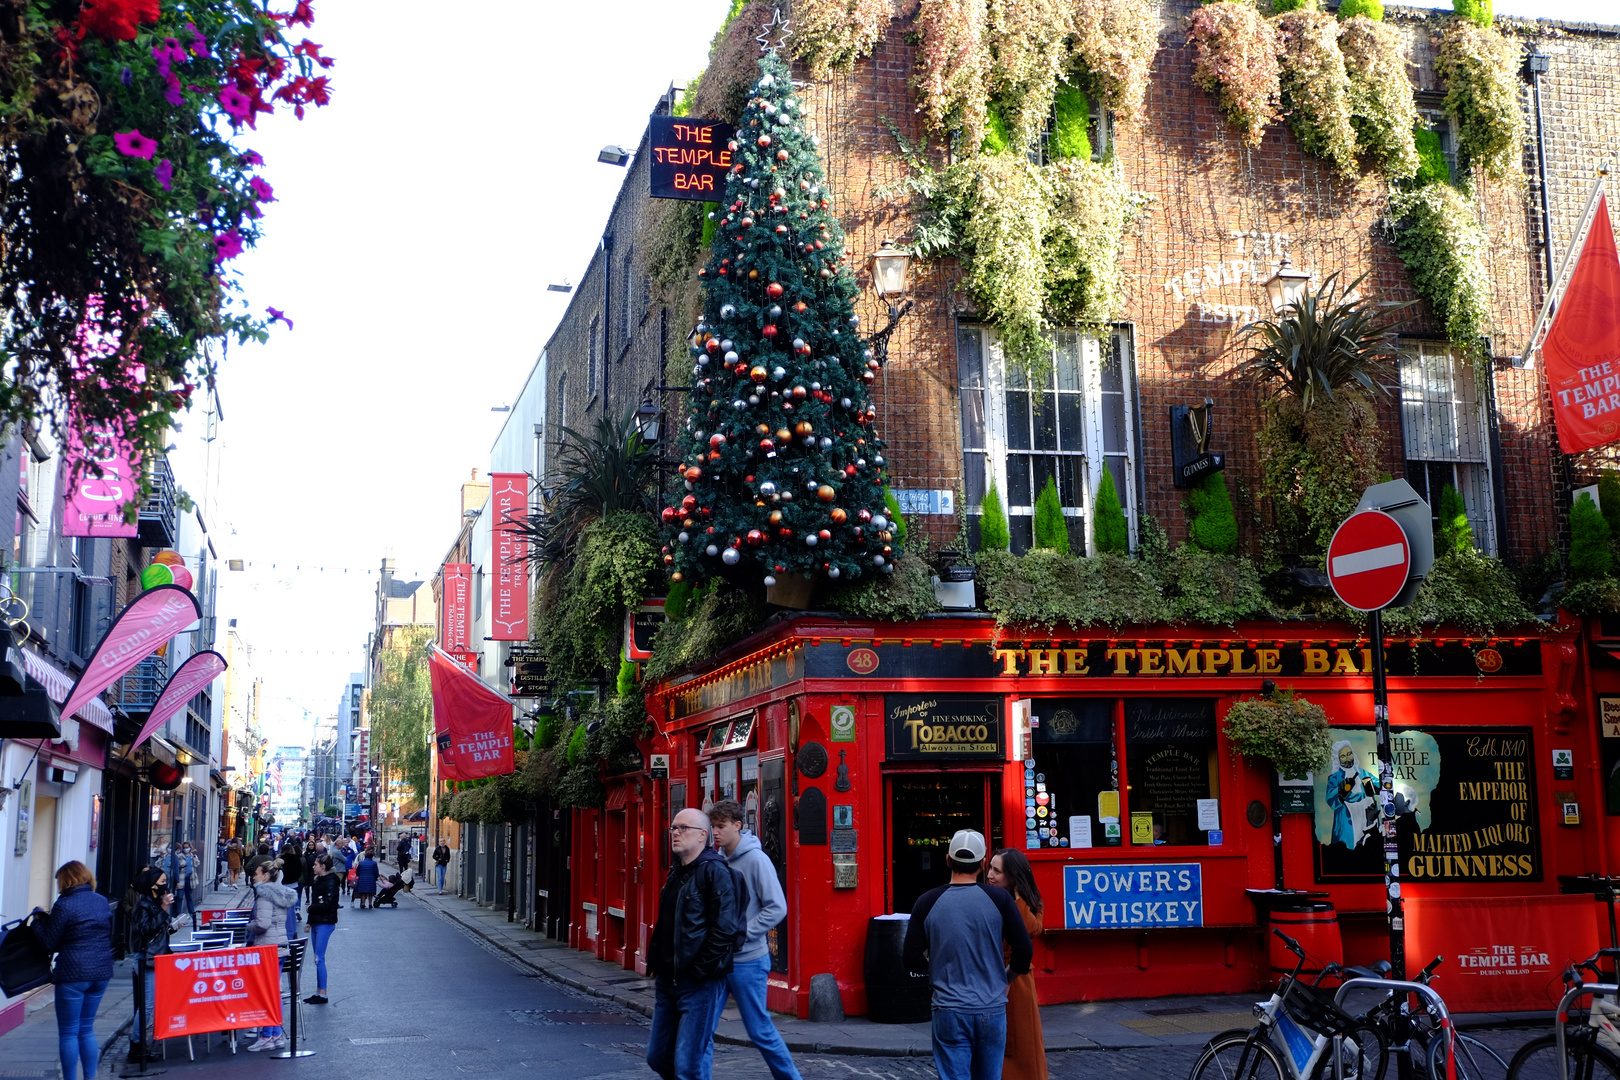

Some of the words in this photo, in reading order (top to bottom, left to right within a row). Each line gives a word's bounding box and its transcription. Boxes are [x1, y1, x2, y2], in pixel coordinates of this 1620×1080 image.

[673, 125, 712, 143] THE
[654, 147, 732, 167] TEMPLE
[674, 173, 714, 191] BAR
[1578, 361, 1613, 383] THE
[1183, 457, 1209, 477] GUINNESS
[902, 503, 931, 511] SOUTH
[942, 497, 950, 508] 2
[457, 582, 466, 604] THE
[500, 589, 511, 618] THE
[101, 628, 150, 668] CLOUD
[150, 596, 187, 631] NINE
[852, 653, 872, 668] 48
[997, 648, 1090, 676] THE
[1107, 648, 1284, 676] TEMPLE
[748, 661, 772, 693] BAR
[162, 680, 195, 710] CLOUD
[890, 700, 937, 719] Importers
[932, 715, 950, 723] FINE
[951, 715, 987, 723] SMOKING
[473, 731, 496, 741] THE
[903, 719, 988, 749] TOBACCO
[457, 736, 510, 755] TEMPLE
[921, 744, 953, 752] Always
[969, 743, 996, 751] Stock
[1501, 739, 1526, 757] 1840
[473, 750, 502, 762] BAR
[1146, 749, 1180, 766] TEMPLE
[1183, 751, 1200, 766] BAR
[1368, 752, 1430, 766] TMPLE
[1395, 766, 1417, 780] AR
[1494, 761, 1526, 780] THE
[1459, 781, 1528, 801] EMPEROR
[1510, 802, 1527, 821] OF
[1413, 832, 1472, 853] MALTED
[1473, 822, 1532, 849] LIQUORS
[1408, 855, 1533, 877] GUINNESS
[1075, 869, 1192, 893] POWER'S
[1068, 900, 1199, 925] WHISKEY
[1492, 945, 1516, 955] THE
[193, 955, 235, 971] TEMPLE
[236, 952, 261, 967] BAR
[1458, 954, 1517, 968] TEMPLE
[1520, 953, 1551, 966] BAR
